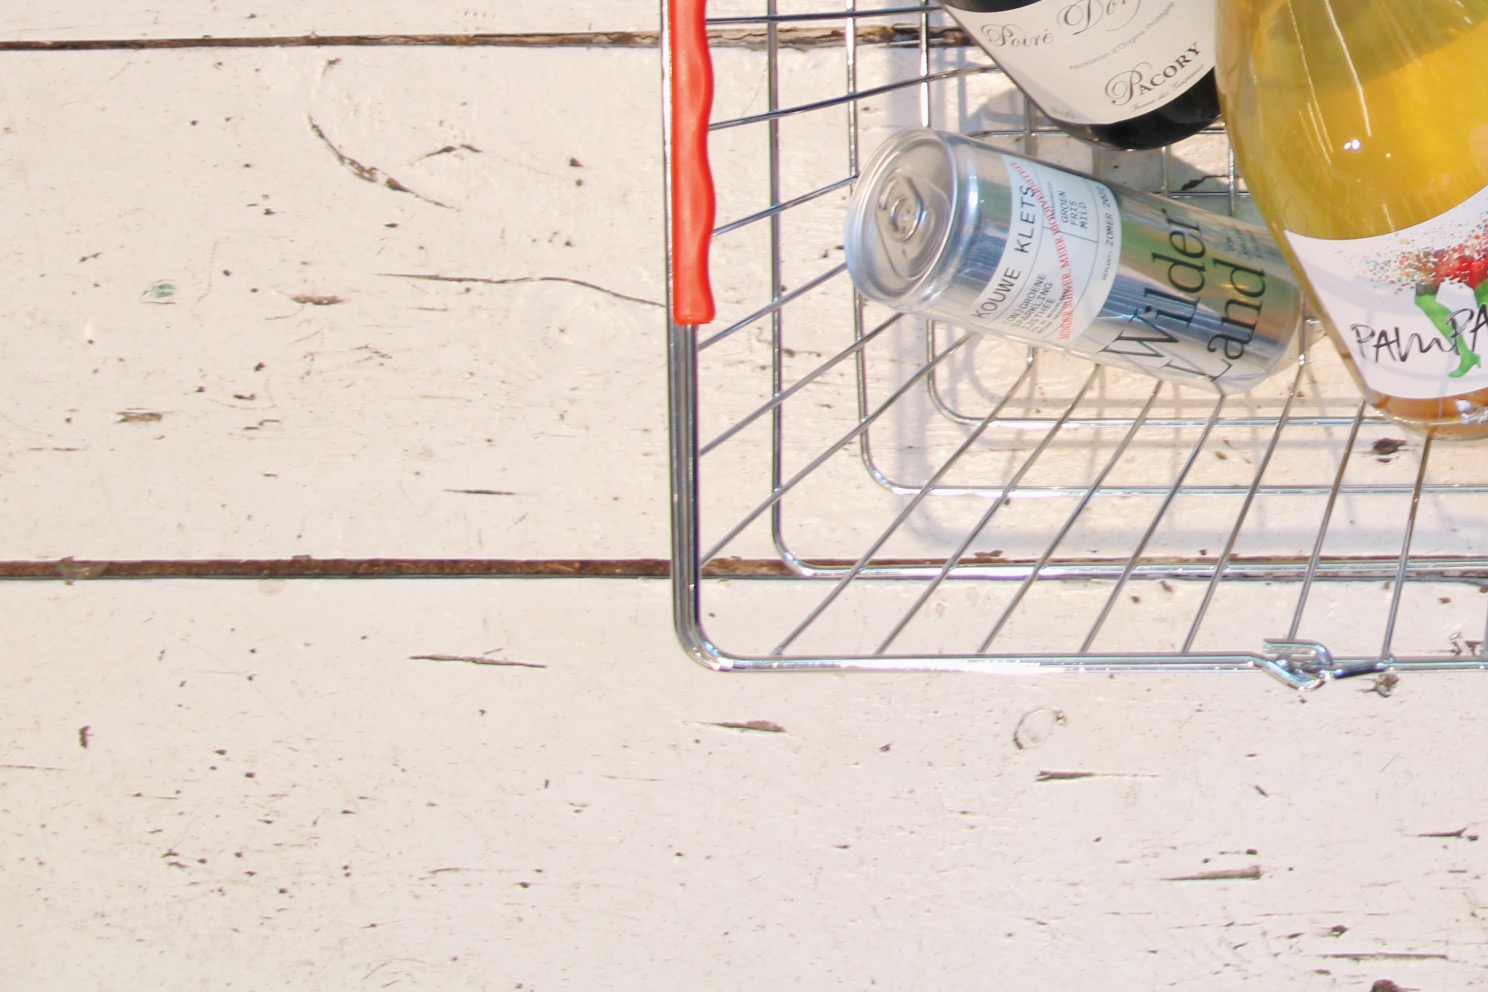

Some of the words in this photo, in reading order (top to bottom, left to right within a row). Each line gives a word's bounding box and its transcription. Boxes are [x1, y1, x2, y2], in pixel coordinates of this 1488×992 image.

[981, 23, 1054, 48] Poiré
[1058, 190, 1069, 223] GROEN
[1069, 200, 1078, 226] FRIS
[1078, 201, 1088, 229] MILD
[1105, 212, 1114, 247] ZOMER
[970, 266, 1021, 319] KOUWE
[1014, 184, 1036, 253] KLETS
[1055, 235, 1069, 268] MEER
[1096, 208, 1206, 358] Wilder
[1012, 282, 1054, 327] SPARKLING
[1159, 258, 1266, 382] Land
